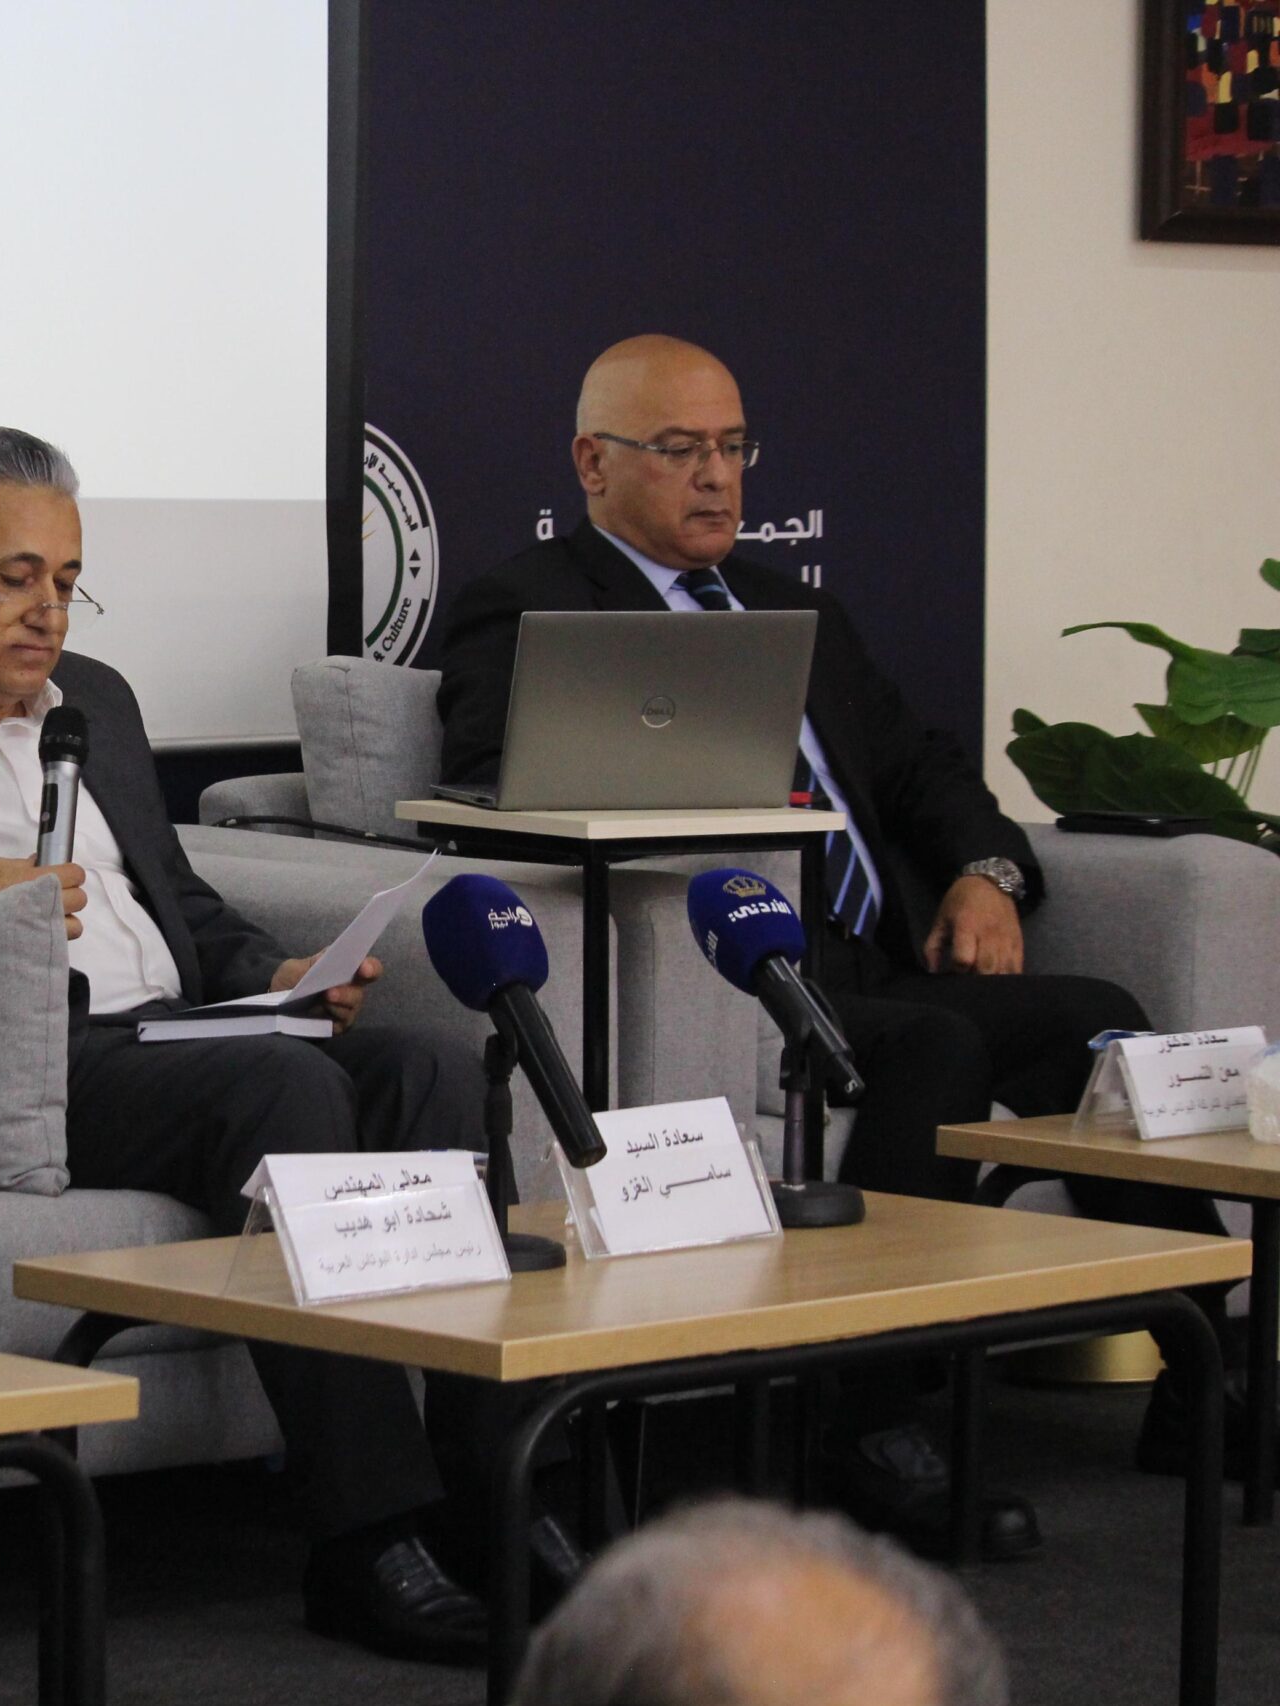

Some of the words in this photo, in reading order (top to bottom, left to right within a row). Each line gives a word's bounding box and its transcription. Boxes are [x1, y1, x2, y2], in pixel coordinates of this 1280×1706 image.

[382, 597, 412, 652] Culture
[627, 1132, 660, 1159] السيد
[662, 1128, 704, 1147] سعادة
[324, 1173, 386, 1200] المهندس
[403, 1202, 452, 1224] شحادة
